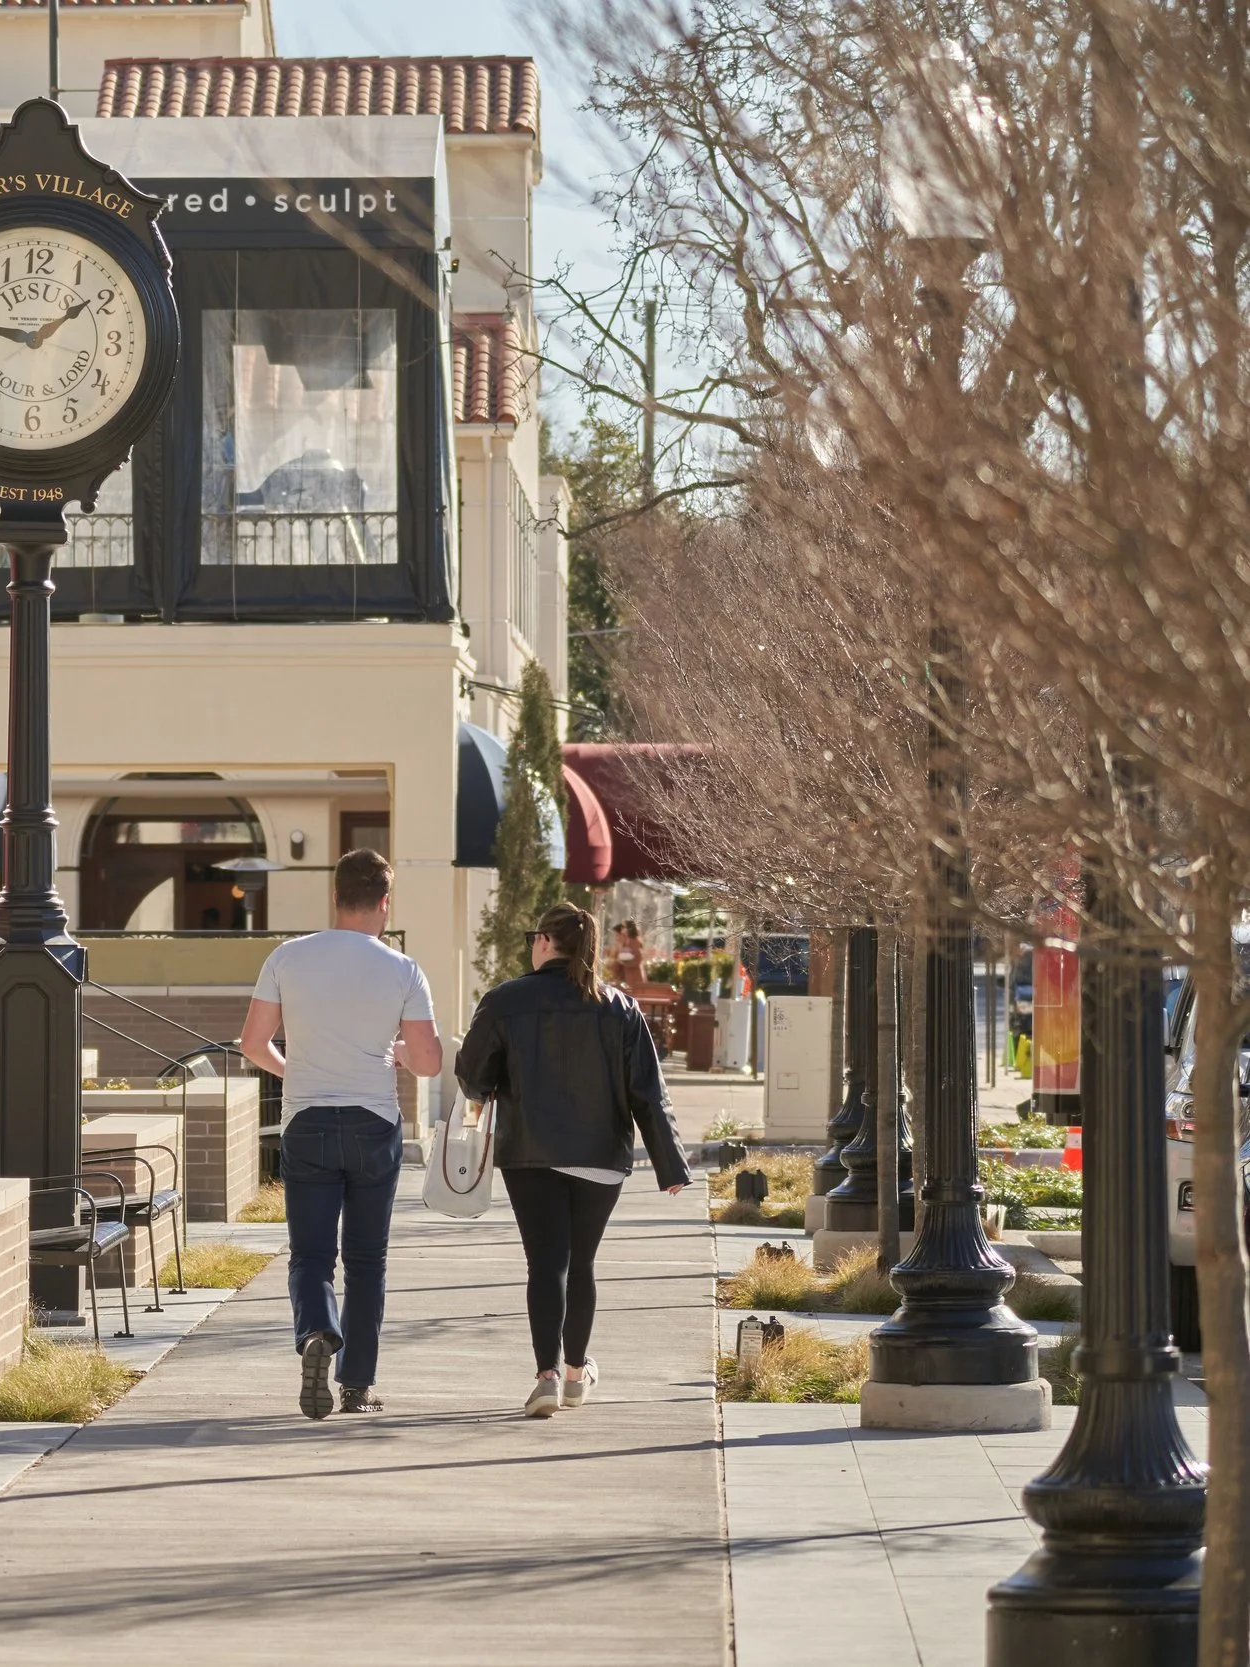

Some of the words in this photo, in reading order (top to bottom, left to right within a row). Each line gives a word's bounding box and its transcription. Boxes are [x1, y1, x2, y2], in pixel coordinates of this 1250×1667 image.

[35, 173, 135, 220] VILLAGE
[150, 187, 228, 212] red
[274, 187, 397, 218] sculpt
[25, 248, 55, 275] 12
[72, 259, 82, 286] 1
[0, 282, 75, 312] JESUS
[96, 289, 116, 316] 2
[104, 330, 122, 357] 3
[42, 383, 56, 397] &
[58, 349, 90, 390] LORD
[91, 368, 111, 397] 4
[24, 405, 41, 432] 6
[62, 396, 79, 424] 5
[32, 487, 64, 502] 1948
